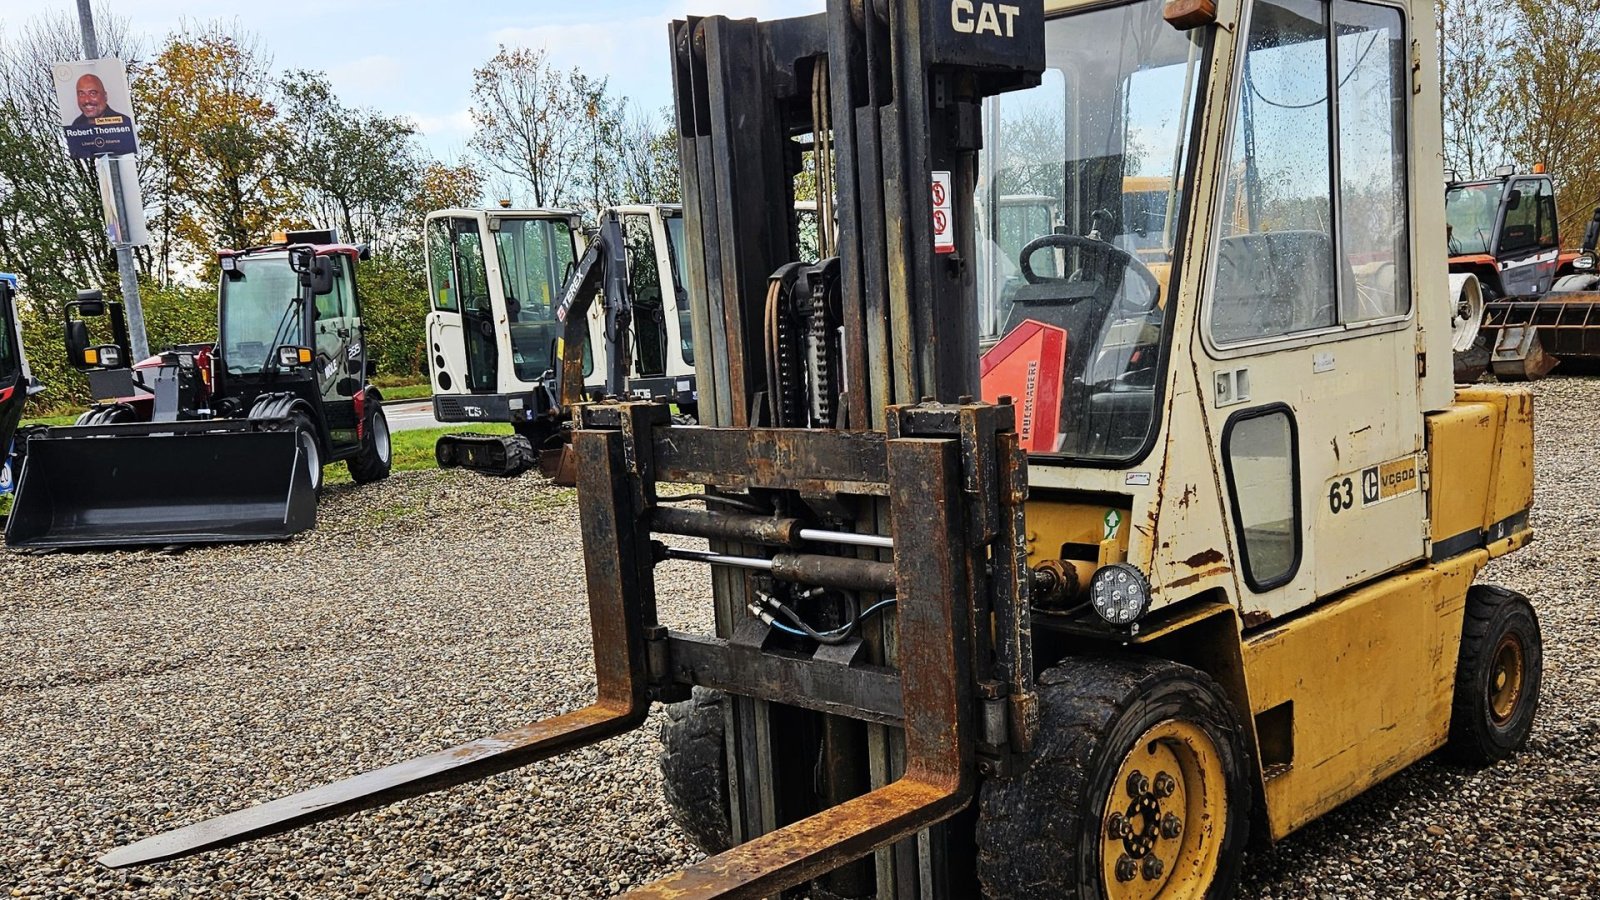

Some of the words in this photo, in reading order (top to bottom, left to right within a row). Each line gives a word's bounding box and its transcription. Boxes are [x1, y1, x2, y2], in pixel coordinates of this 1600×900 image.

[951, 0, 1020, 38] CAT
[66, 128, 93, 137] Robert
[94, 126, 131, 135] Thomsen
[562, 266, 584, 309] TEREX
[1021, 360, 1038, 442] TRUCKLAGERE
[1329, 477, 1354, 515] 63
[1381, 468, 1415, 488] VC60D
